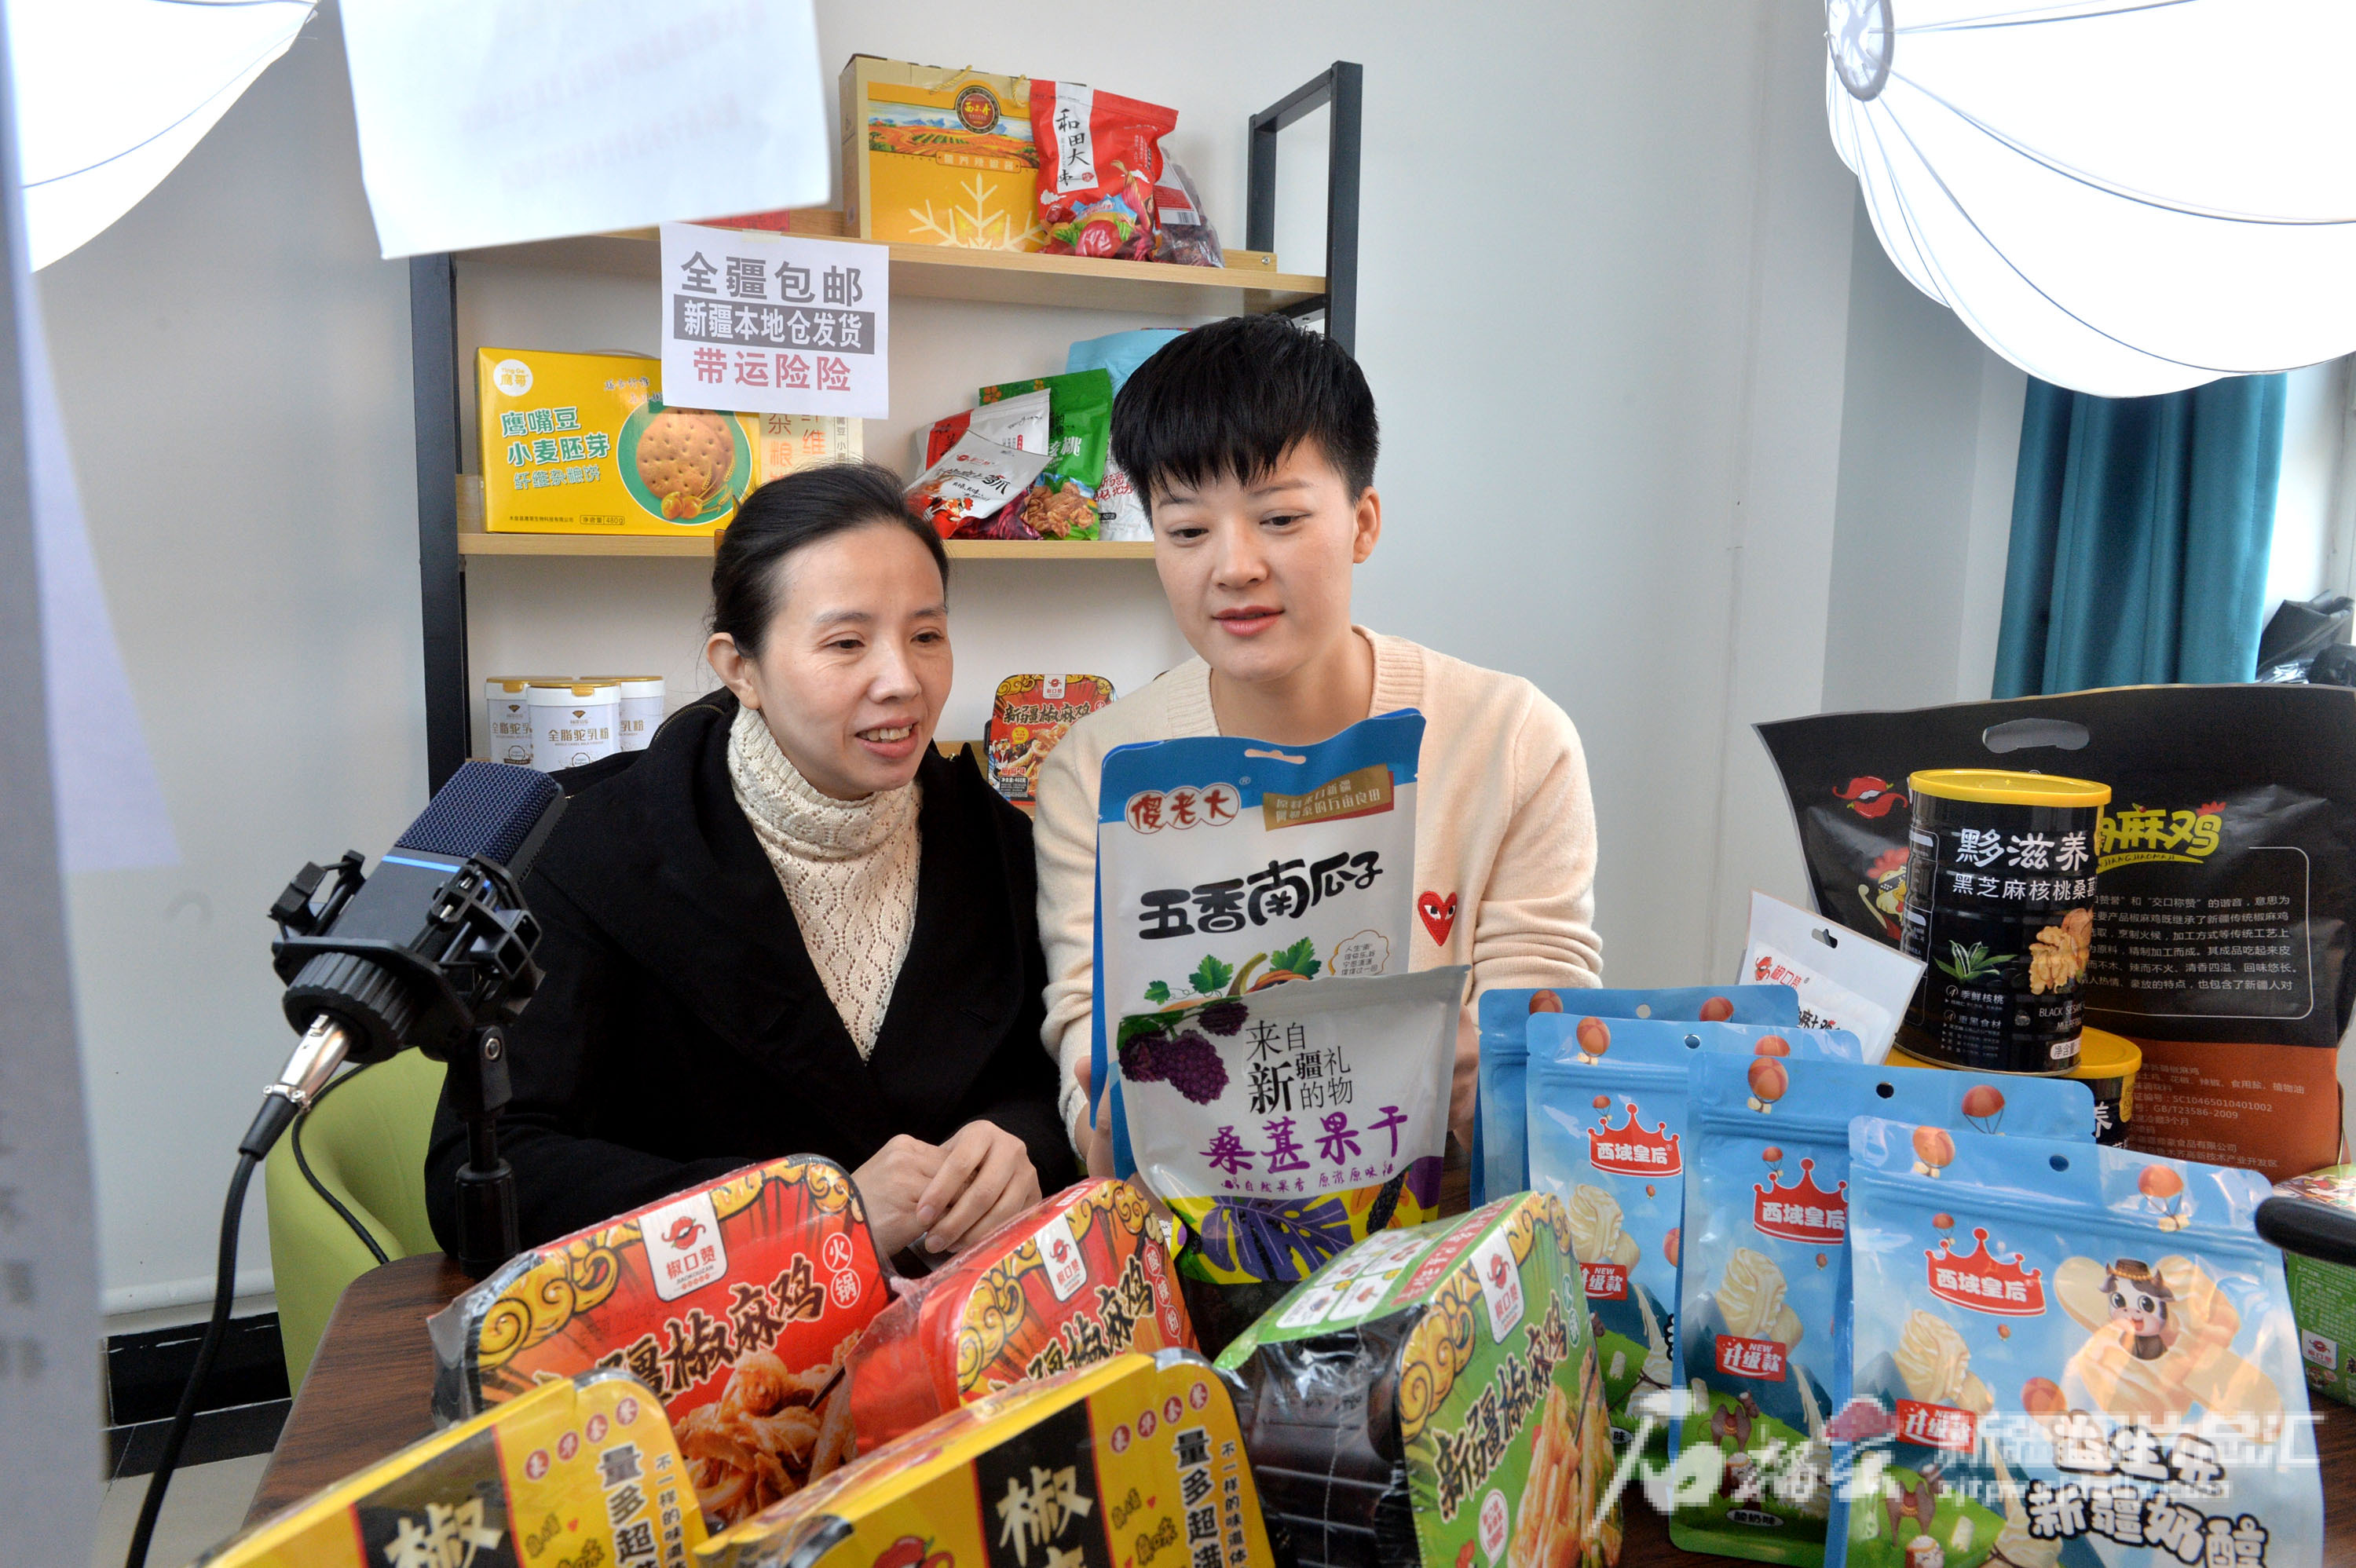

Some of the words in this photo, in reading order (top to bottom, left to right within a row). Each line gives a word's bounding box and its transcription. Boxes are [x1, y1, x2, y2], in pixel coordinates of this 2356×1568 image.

[681, 251, 862, 306] 全疆包邮
[683, 300, 862, 349] 新疆本地仓发货
[693, 347, 851, 392] 带运险险
[500, 406, 581, 437] 鹰嘴豆
[507, 432, 611, 467] 小麦胚芽
[768, 414, 792, 481] 杂粮
[513, 464, 601, 491] 纤维杂粮饼
[1003, 702, 1091, 725] 新疆椒麻鸡
[548, 727, 609, 742] 全脂驼乳粉
[1131, 789, 1236, 831] 傻老大
[1139, 851, 1384, 940] 五香南瓜子
[2039, 1007, 2063, 1018] BLACK
[1245, 1020, 1306, 1062] 来自
[1199, 1106, 1408, 1175] 桑葚果干
[1597, 1143, 1668, 1165] 西域皇后
[1245, 1177, 1305, 1193] 自然果香
[1319, 1166, 1377, 1187] 原滋原味
[1762, 1200, 1846, 1230] 西域皇后
[666, 1245, 716, 1280] 椒口赞
[826, 1237, 858, 1305] 火锅
[1594, 1266, 1615, 1276] NEW
[1935, 1267, 2028, 1303] 西域皇后
[534, 1253, 826, 1402] 疆椒麻鸡
[991, 1255, 1155, 1391] 疆椒麻鸡
[1724, 1345, 1781, 1372] 升级款
[1749, 1343, 1772, 1353] NEW
[1434, 1292, 1568, 1523] 新疆椒麻鸡
[598, 1444, 657, 1568] 量多超
[997, 1465, 1093, 1568] 椒
[1733, 1511, 1776, 1526] 酸奶味
